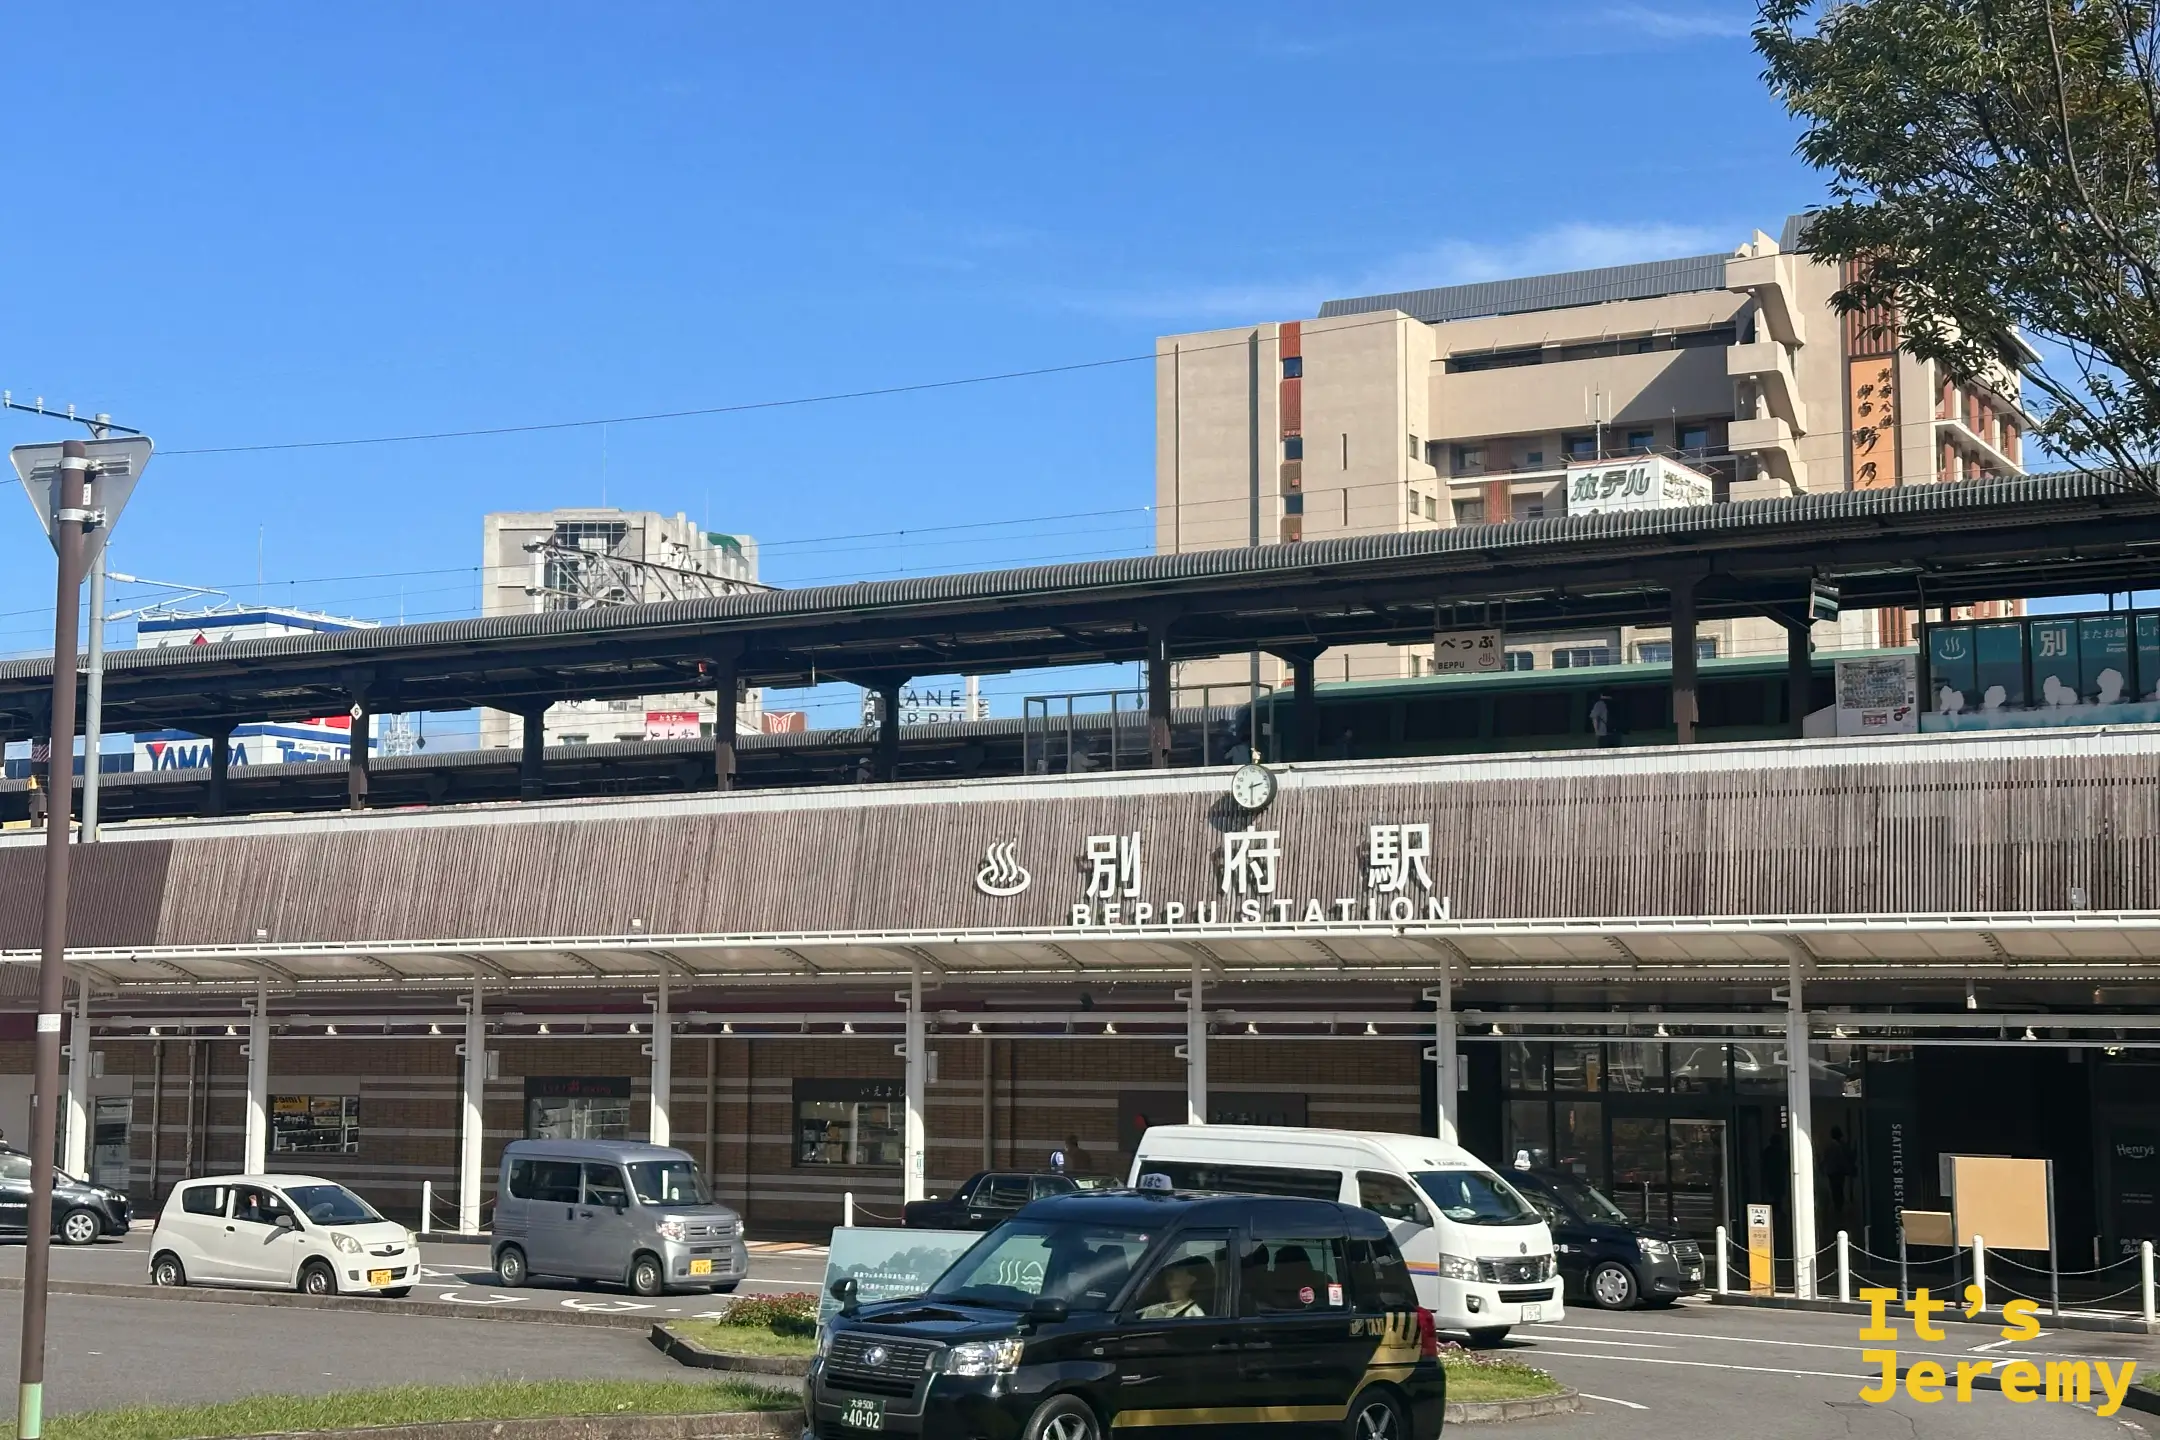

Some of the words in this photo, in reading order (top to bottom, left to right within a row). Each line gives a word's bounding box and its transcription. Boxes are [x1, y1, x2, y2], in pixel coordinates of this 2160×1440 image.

[1571, 468, 1650, 502] ホテル
[2039, 628, 2067, 657] 別
[1438, 661, 1465, 670] BEPPU
[1086, 824, 1433, 899] 別府駅
[1072, 901, 1218, 927] BEPPU
[1241, 896, 1451, 923] STATION
[1894, 1177, 1904, 1202] BEST
